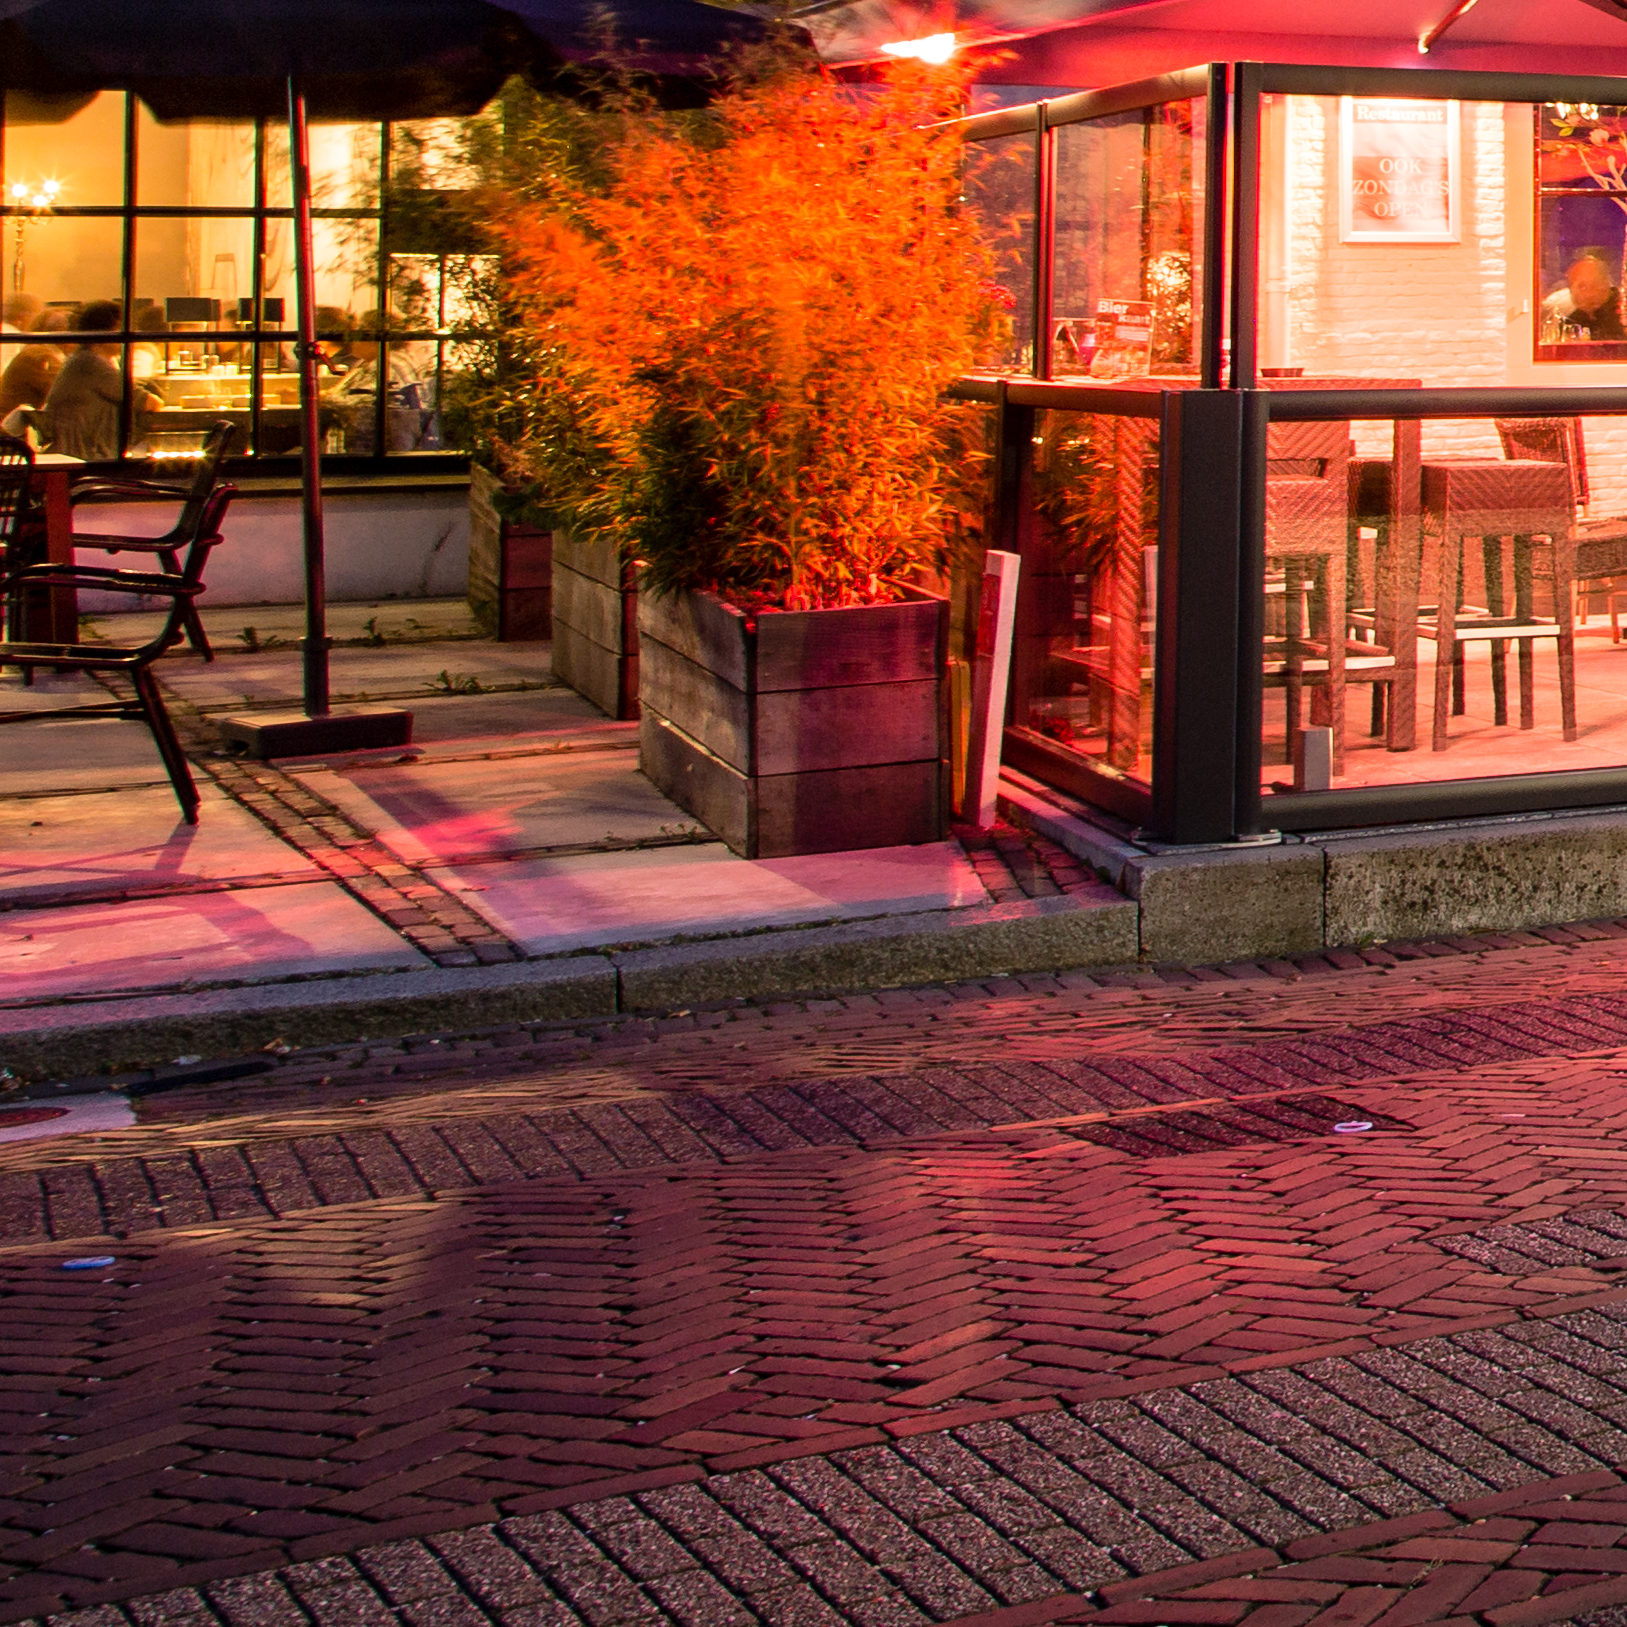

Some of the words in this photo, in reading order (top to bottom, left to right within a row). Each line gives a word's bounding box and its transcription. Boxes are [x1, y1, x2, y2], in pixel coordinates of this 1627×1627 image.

[1356, 105, 1444, 122] Restaurant
[1379, 158, 1423, 174] OOK
[1352, 179, 1450, 196] ZONDAG'S
[1374, 201, 1430, 217] OPEN
[1097, 300, 1129, 314] Bier
